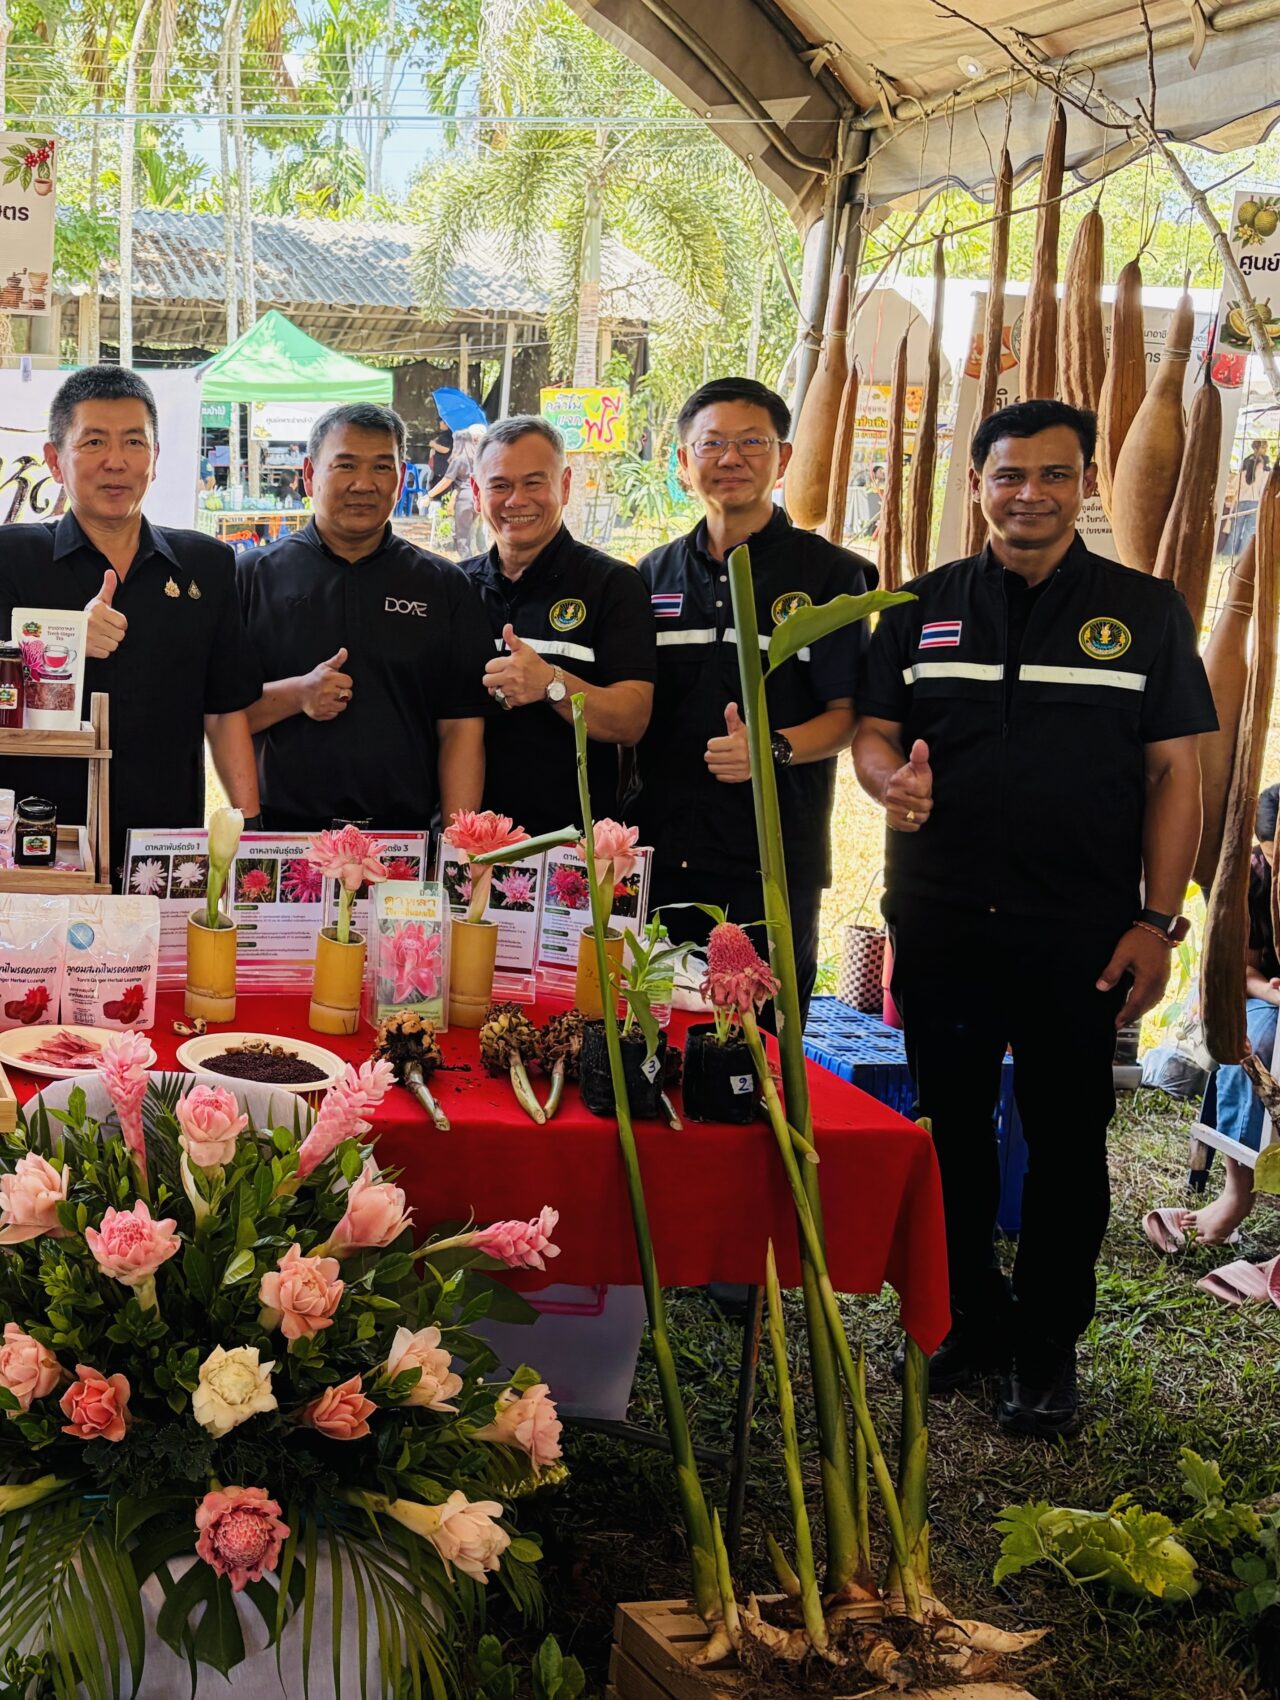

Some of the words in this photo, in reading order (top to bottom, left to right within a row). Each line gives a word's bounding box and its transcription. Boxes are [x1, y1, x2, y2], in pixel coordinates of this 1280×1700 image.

[584, 396, 619, 443] ฟรี
[648, 1060, 656, 1073] 3
[738, 1077, 750, 1091] 2
